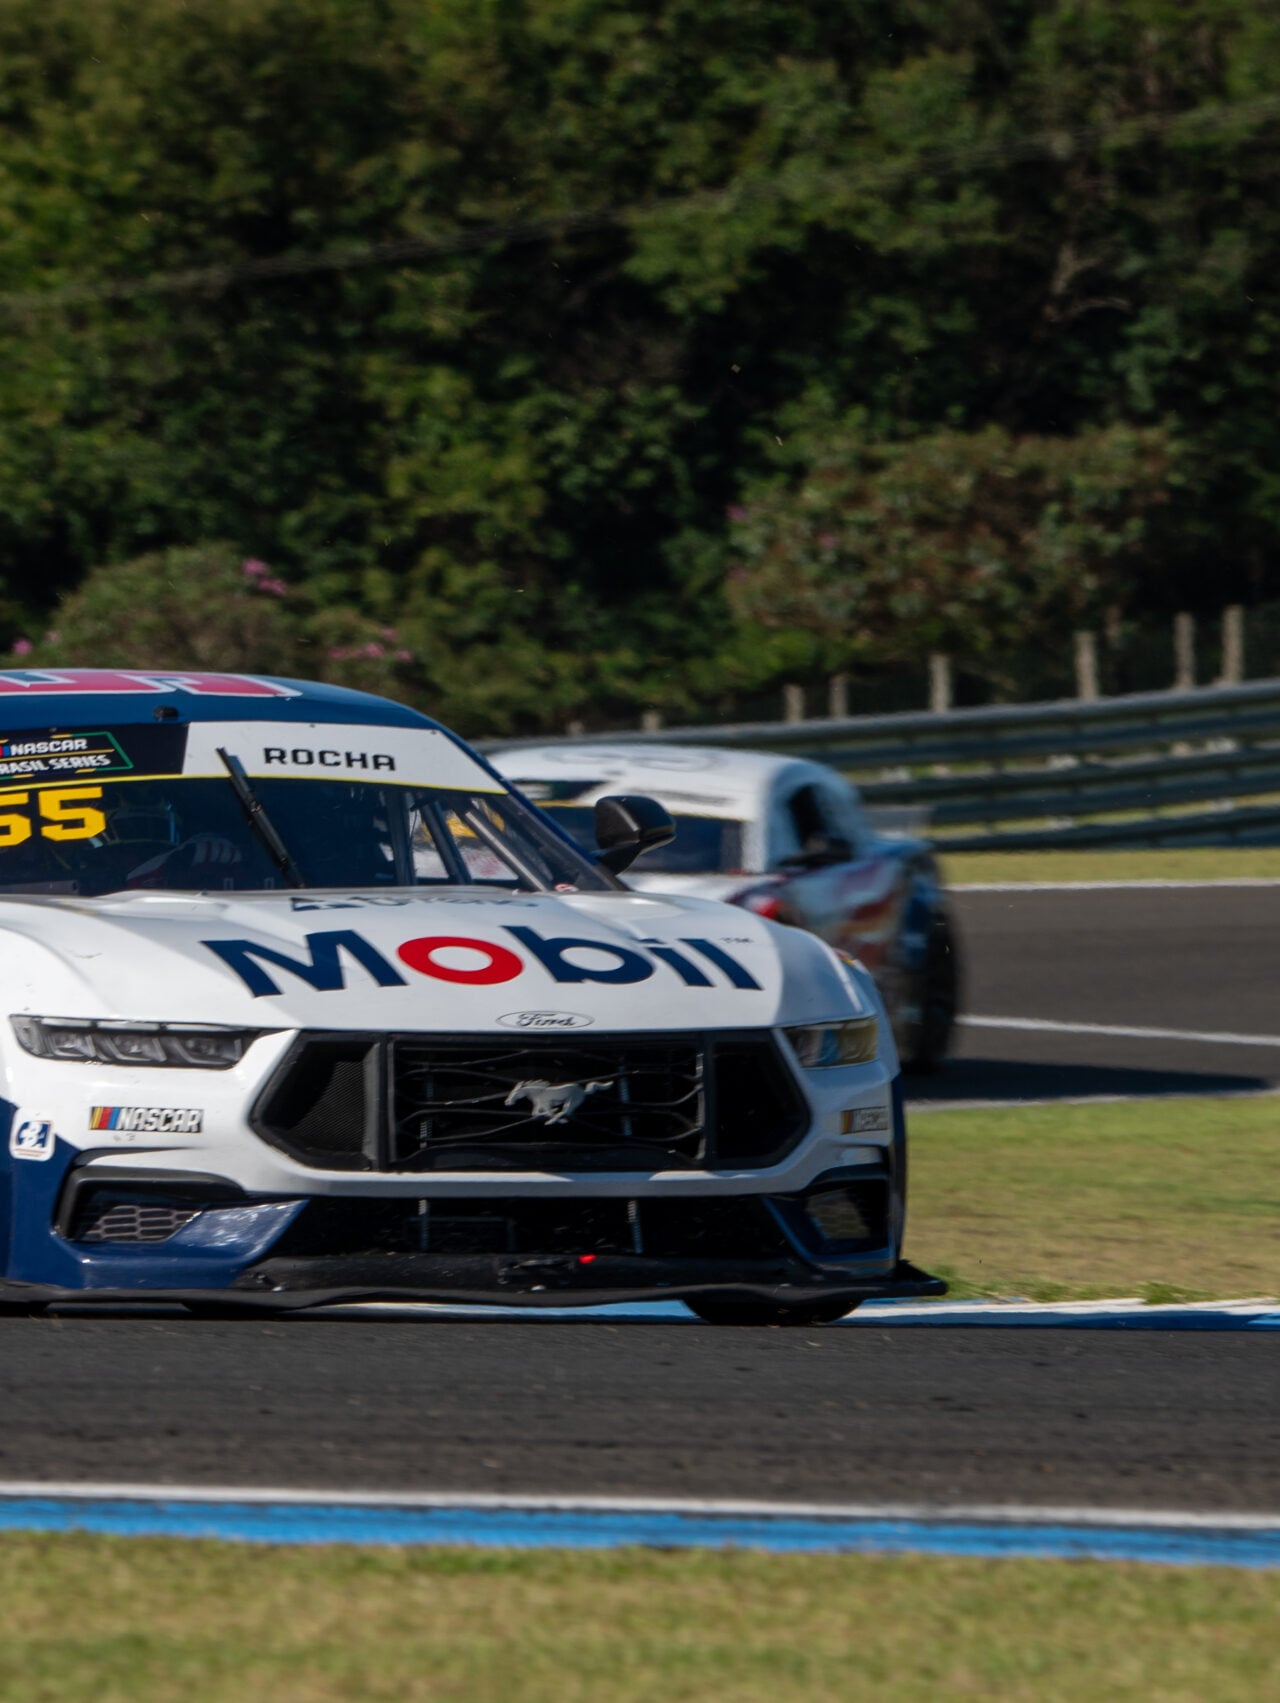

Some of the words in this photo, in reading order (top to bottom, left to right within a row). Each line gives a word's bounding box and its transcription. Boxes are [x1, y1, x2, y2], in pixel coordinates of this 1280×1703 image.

[10, 738, 88, 757] NASCAR
[48, 755, 112, 771] SERIES
[263, 747, 396, 771] ROCHA
[200, 925, 764, 998] Mobil
[516, 1013, 576, 1027] Ford
[118, 1108, 202, 1132] NASCAR
